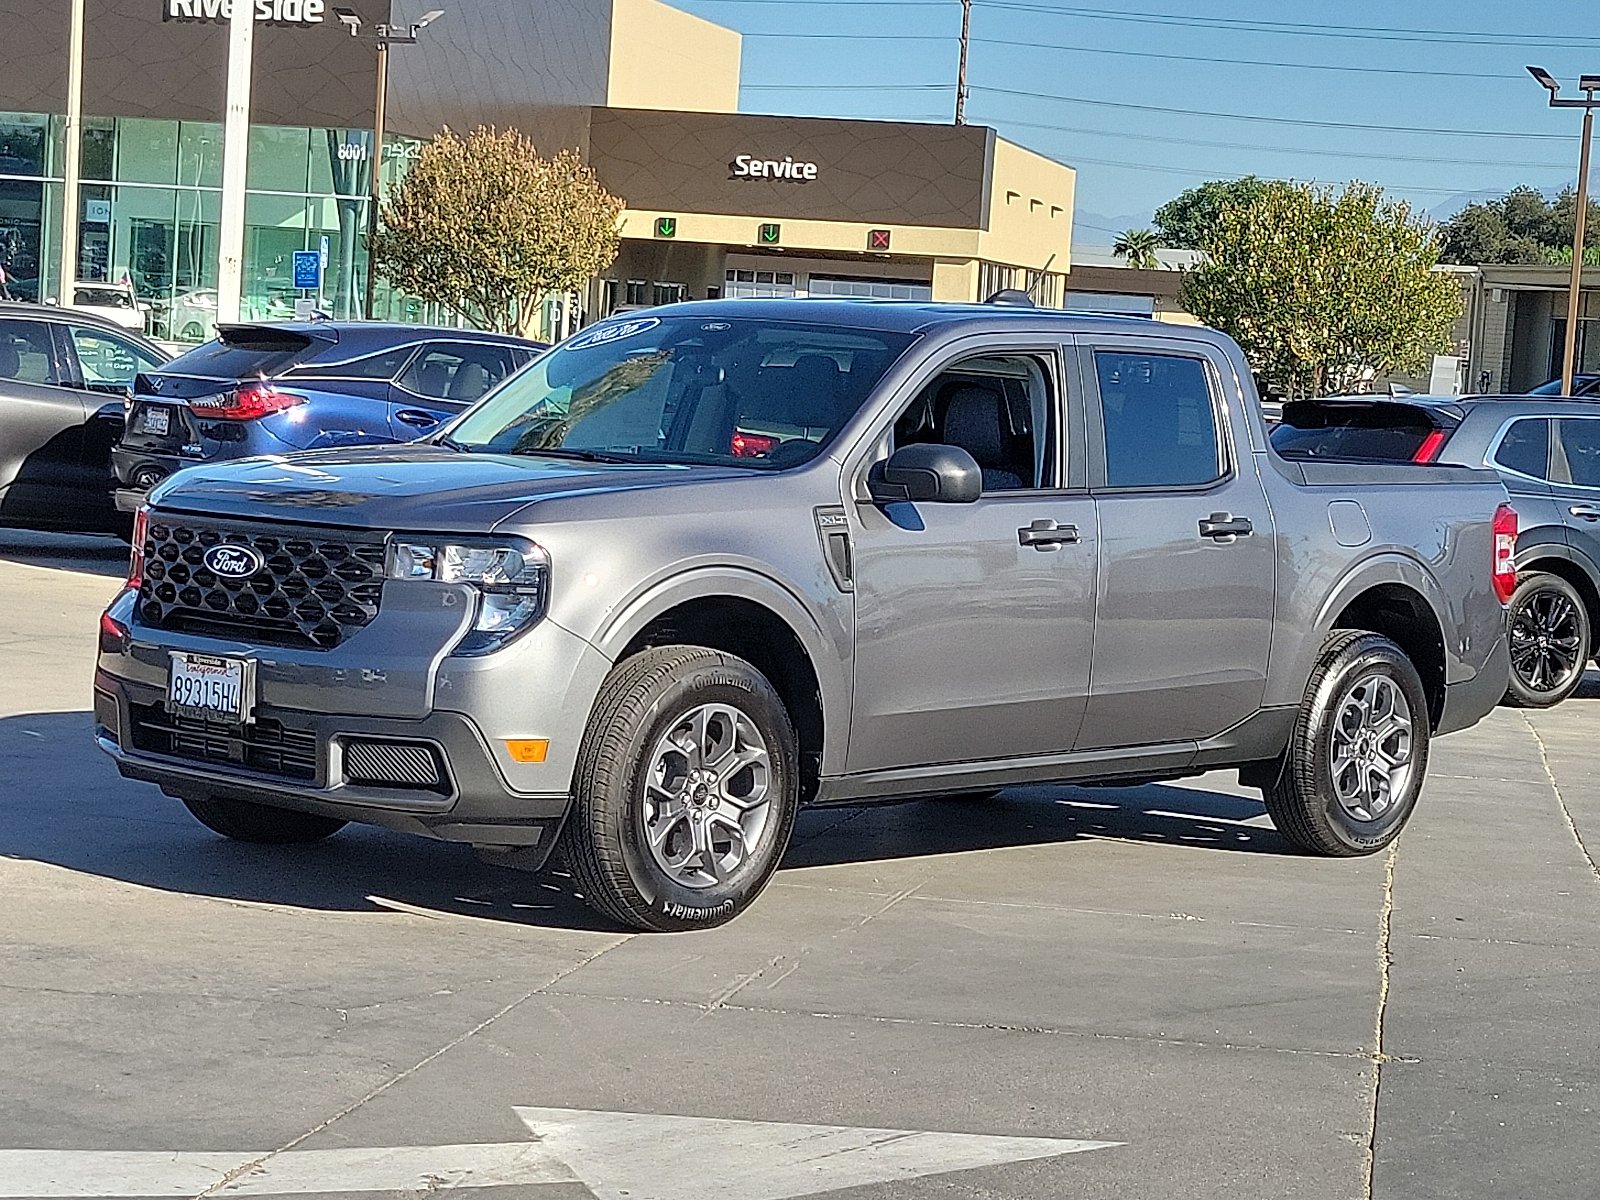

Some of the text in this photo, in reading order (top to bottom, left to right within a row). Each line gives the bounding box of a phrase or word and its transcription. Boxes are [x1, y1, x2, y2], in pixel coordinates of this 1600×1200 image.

[169, 0, 325, 22] Riveside
[734, 155, 818, 180] Service
[213, 550, 248, 573] Ford
[668, 899, 734, 920] Continental
